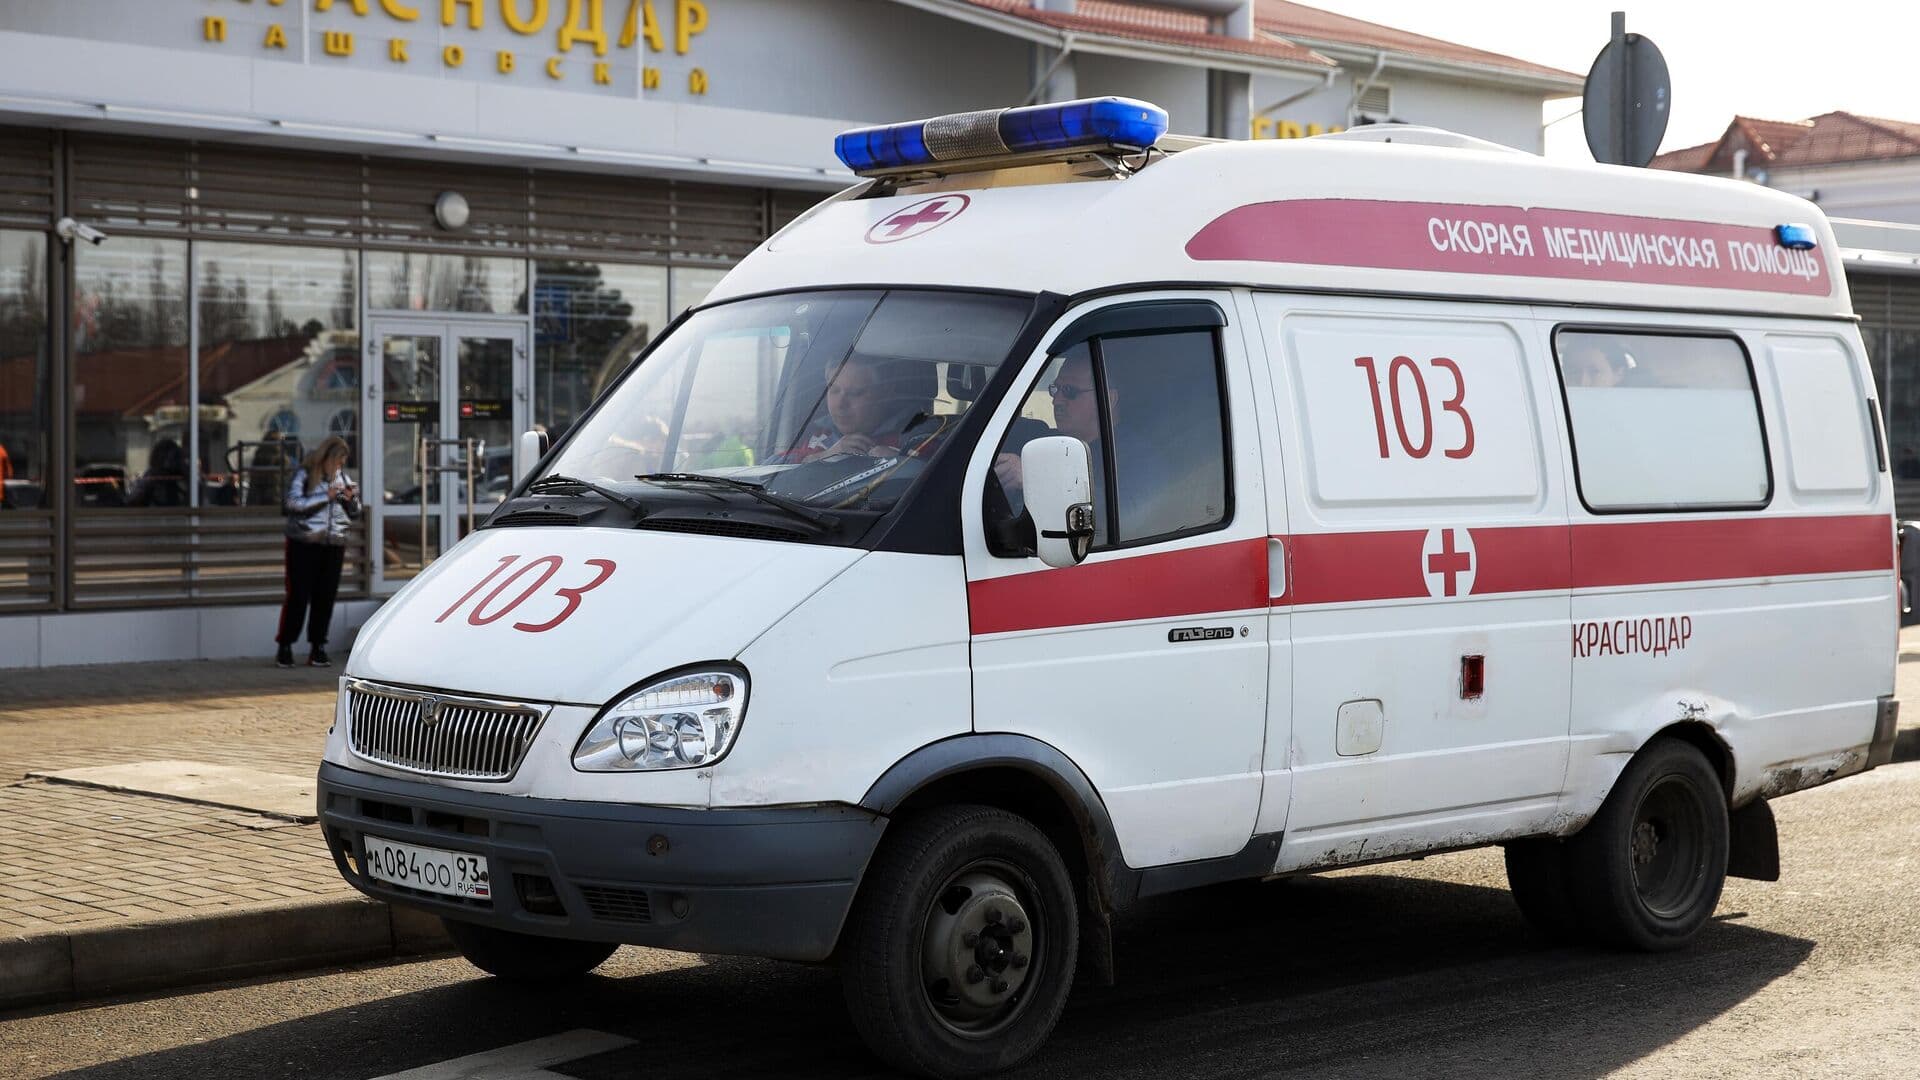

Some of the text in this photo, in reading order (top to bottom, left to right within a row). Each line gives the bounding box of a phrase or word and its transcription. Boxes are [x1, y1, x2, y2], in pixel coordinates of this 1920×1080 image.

[204, 16, 709, 96] ПАШКОВСКИЙ
[1428, 217, 1820, 281] СКОРАЯ МЕДИЦИНСКАЯ ПОМОЩЬ
[1354, 355, 1475, 459] 103
[434, 555, 617, 633] 103
[1573, 615, 1692, 658] КРАСНОДАР
[457, 882, 475, 893] RUS
